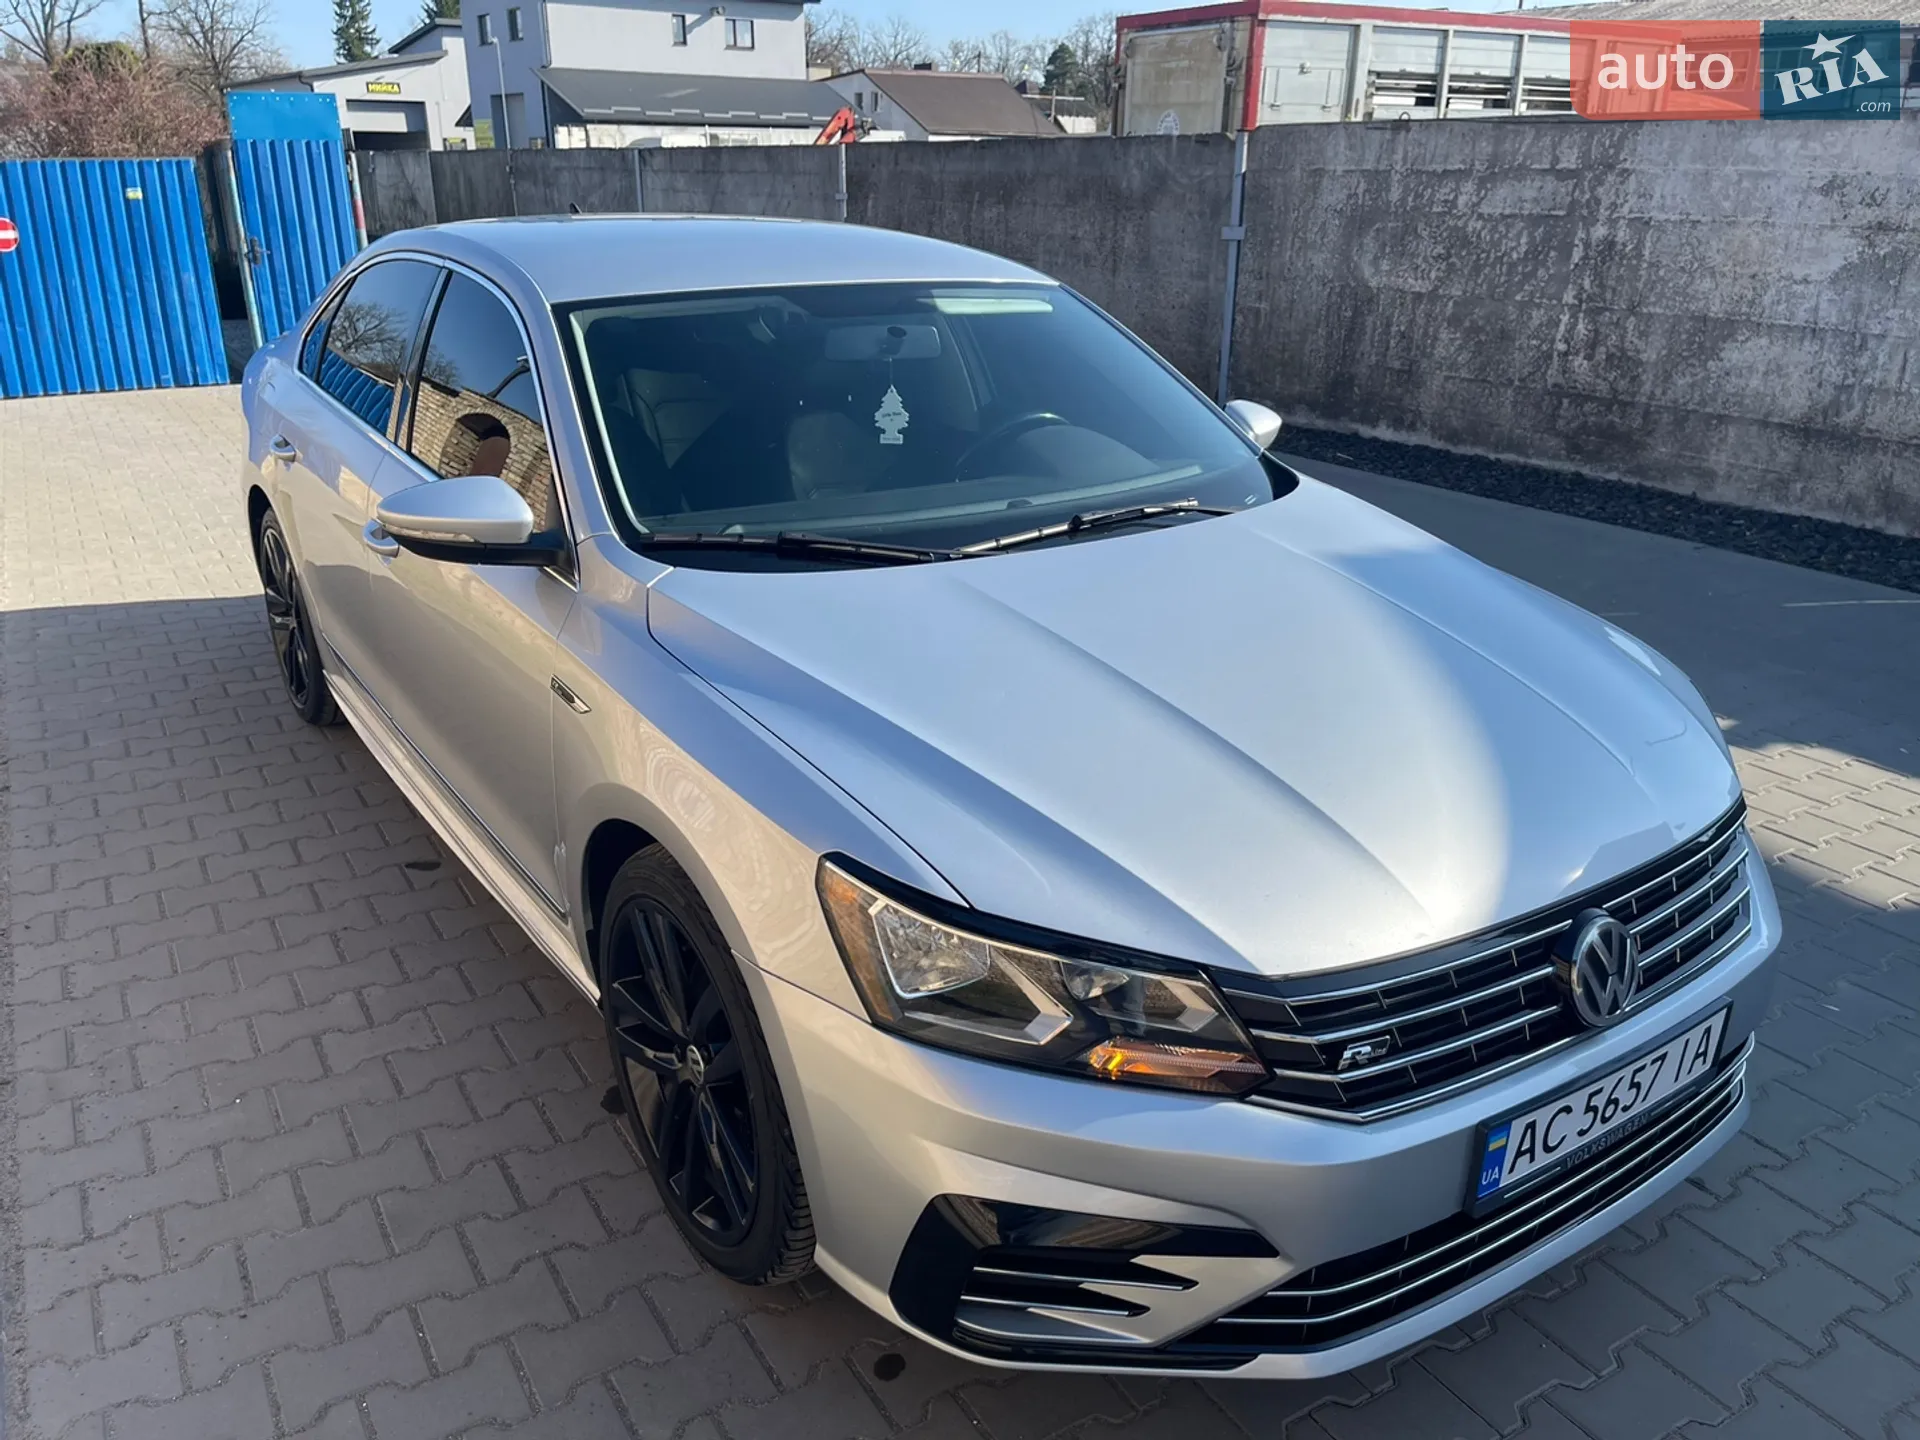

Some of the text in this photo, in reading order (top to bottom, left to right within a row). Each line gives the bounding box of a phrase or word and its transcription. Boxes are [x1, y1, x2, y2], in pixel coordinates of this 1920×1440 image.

[1507, 1023, 1713, 1175] AC 5657 IA
[1481, 1165, 1499, 1185] UA
